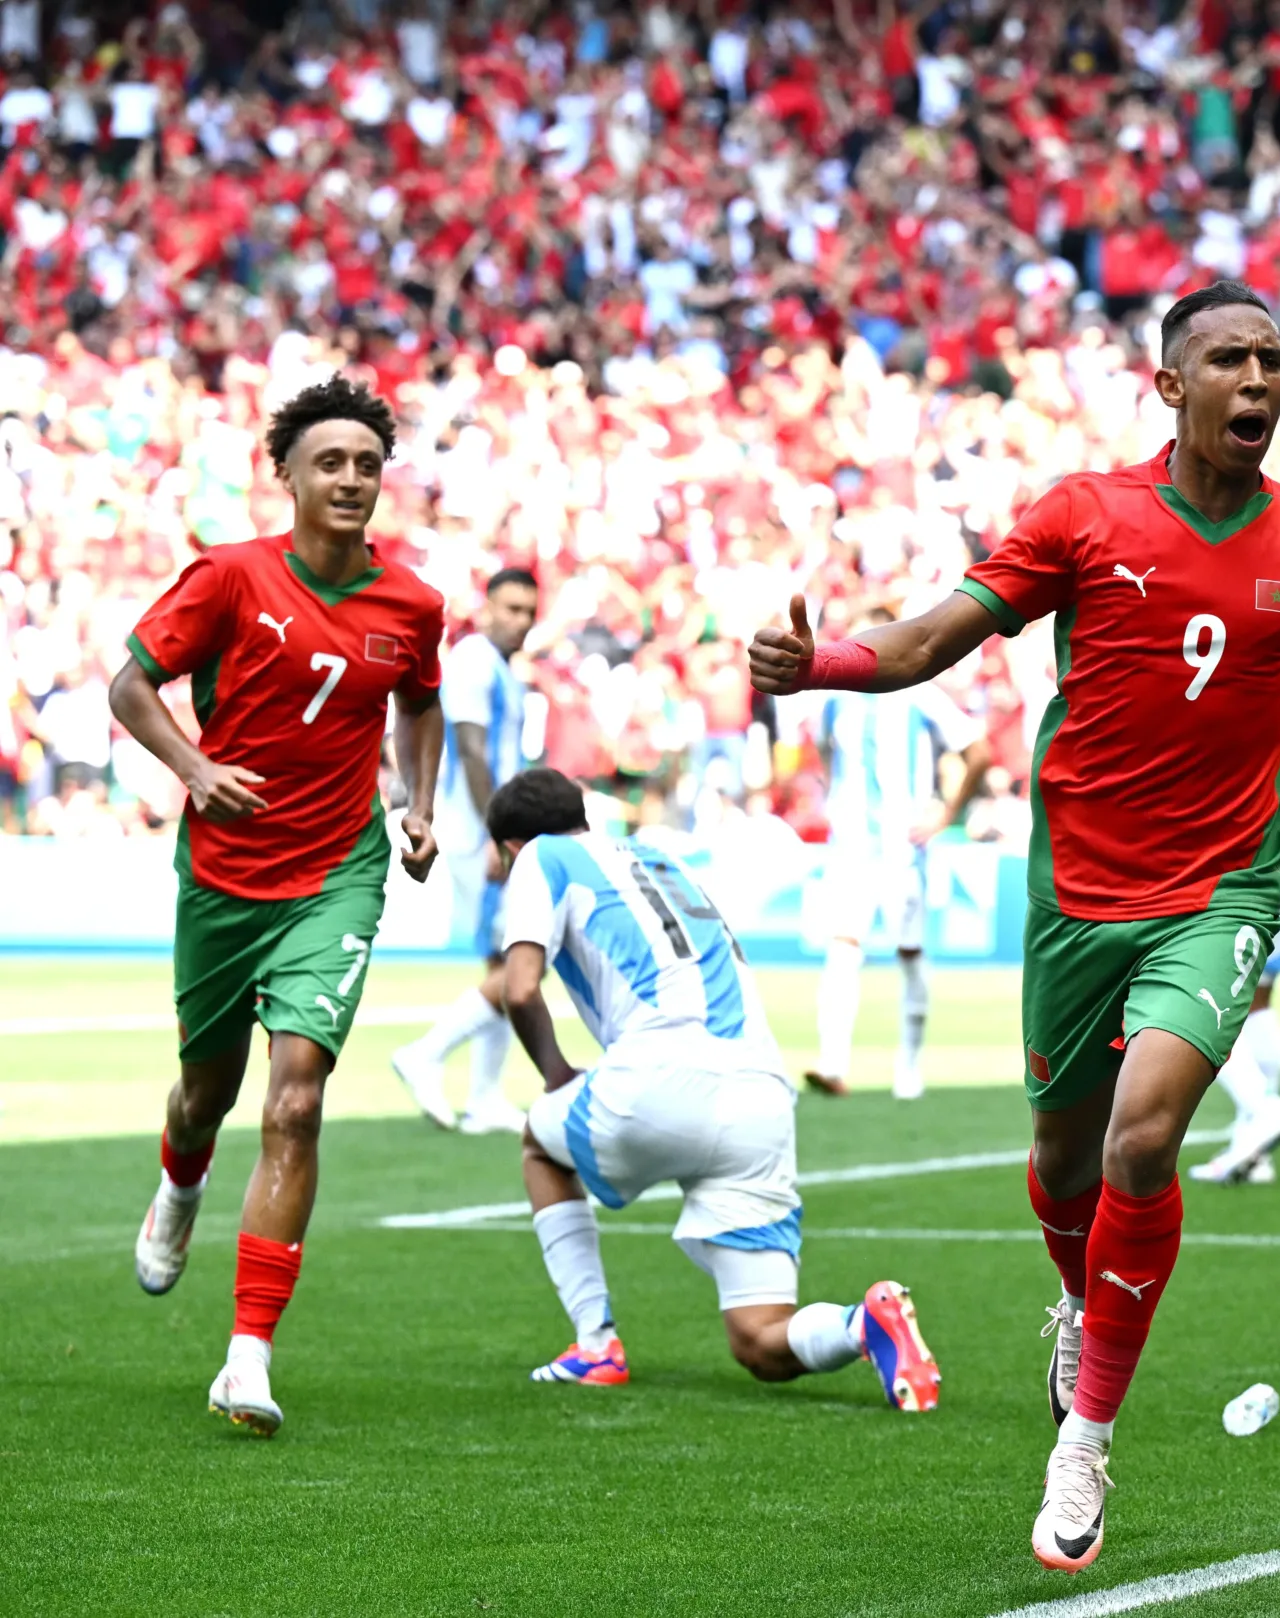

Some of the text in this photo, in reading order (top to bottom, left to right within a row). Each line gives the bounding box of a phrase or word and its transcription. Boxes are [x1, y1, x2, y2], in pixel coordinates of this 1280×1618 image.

[302, 652, 348, 724] 7
[1182, 613, 1226, 701] 9
[337, 933, 368, 997] 7
[1230, 925, 1261, 997] 9
